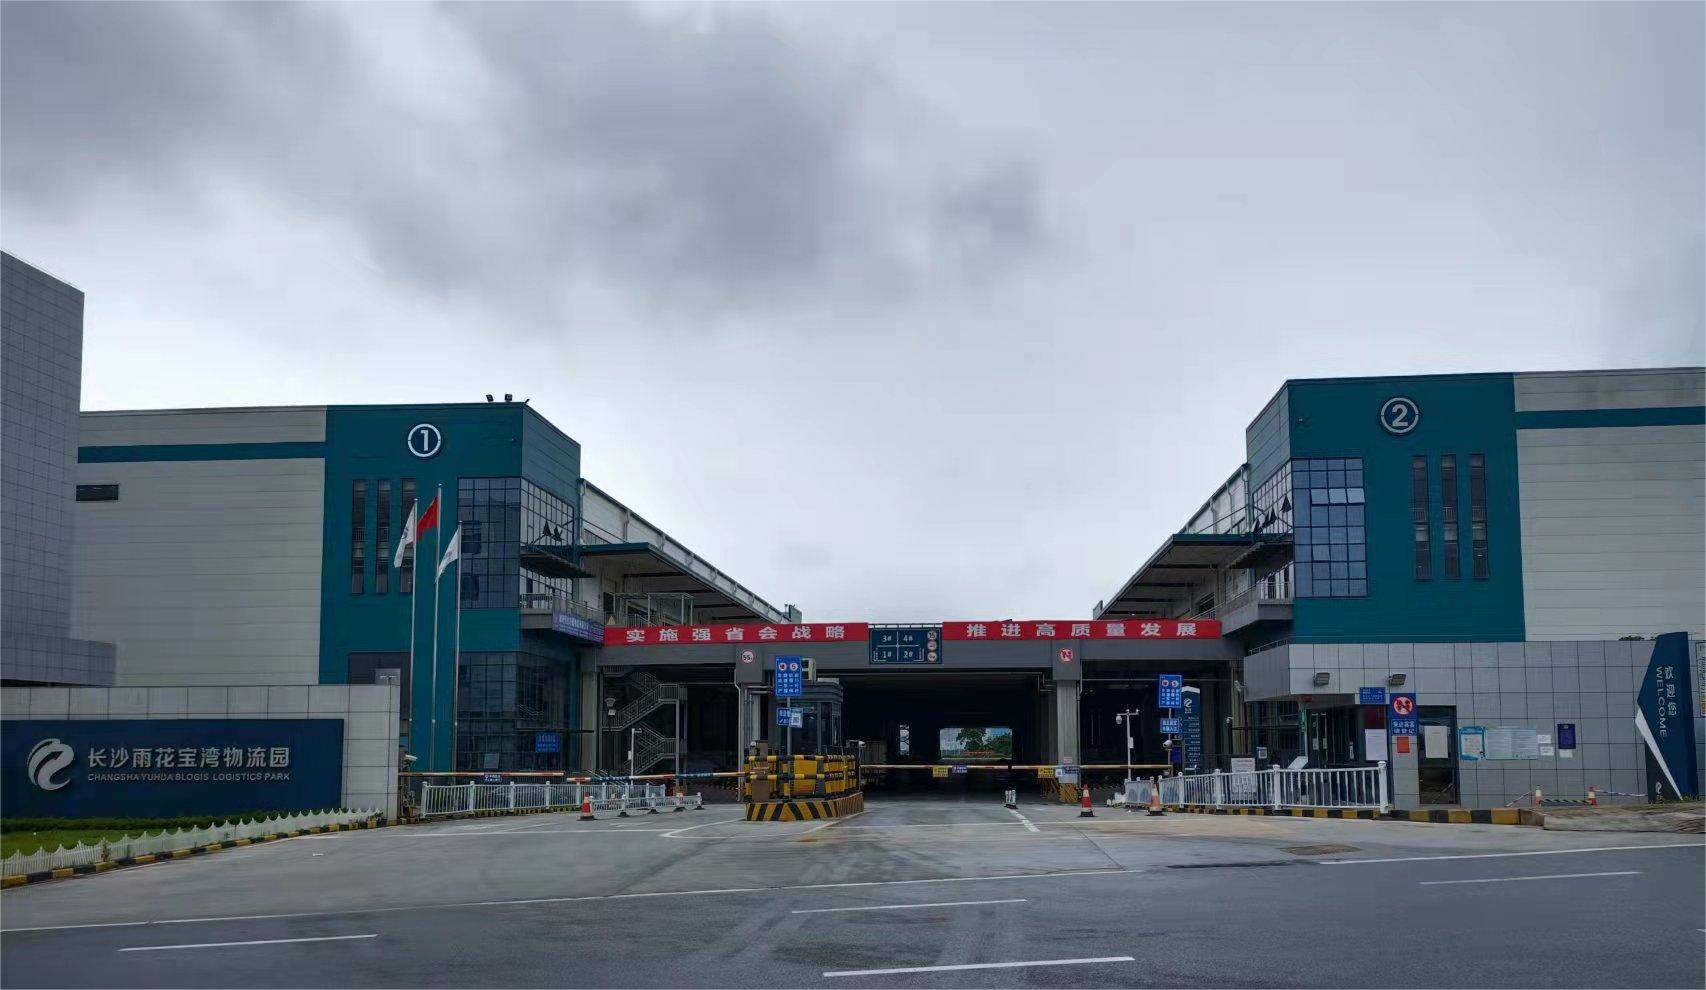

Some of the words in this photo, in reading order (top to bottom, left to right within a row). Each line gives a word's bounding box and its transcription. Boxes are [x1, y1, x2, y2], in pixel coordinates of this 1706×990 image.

[1391, 403, 1409, 427] 2
[420, 429, 429, 451] 1
[626, 625, 845, 643] 实施强省会战略
[882, 634, 892, 643] 3#
[903, 634, 913, 643] 4#
[966, 622, 1198, 638] 推进高质量发展
[882, 650, 892, 659] 1#
[903, 650, 913, 659] 2#
[1664, 666, 1677, 716] 欢迎您
[1655, 666, 1668, 737] WELCOME
[88, 747, 290, 768] 长沙雨花宝湾物流园
[88, 773, 140, 781] CHANGSHA
[141, 773, 174, 781] YUHUA
[175, 772, 209, 781] BLOGIS
[212, 772, 262, 781] LOGISTICS
[264, 772, 290, 781] PARK
